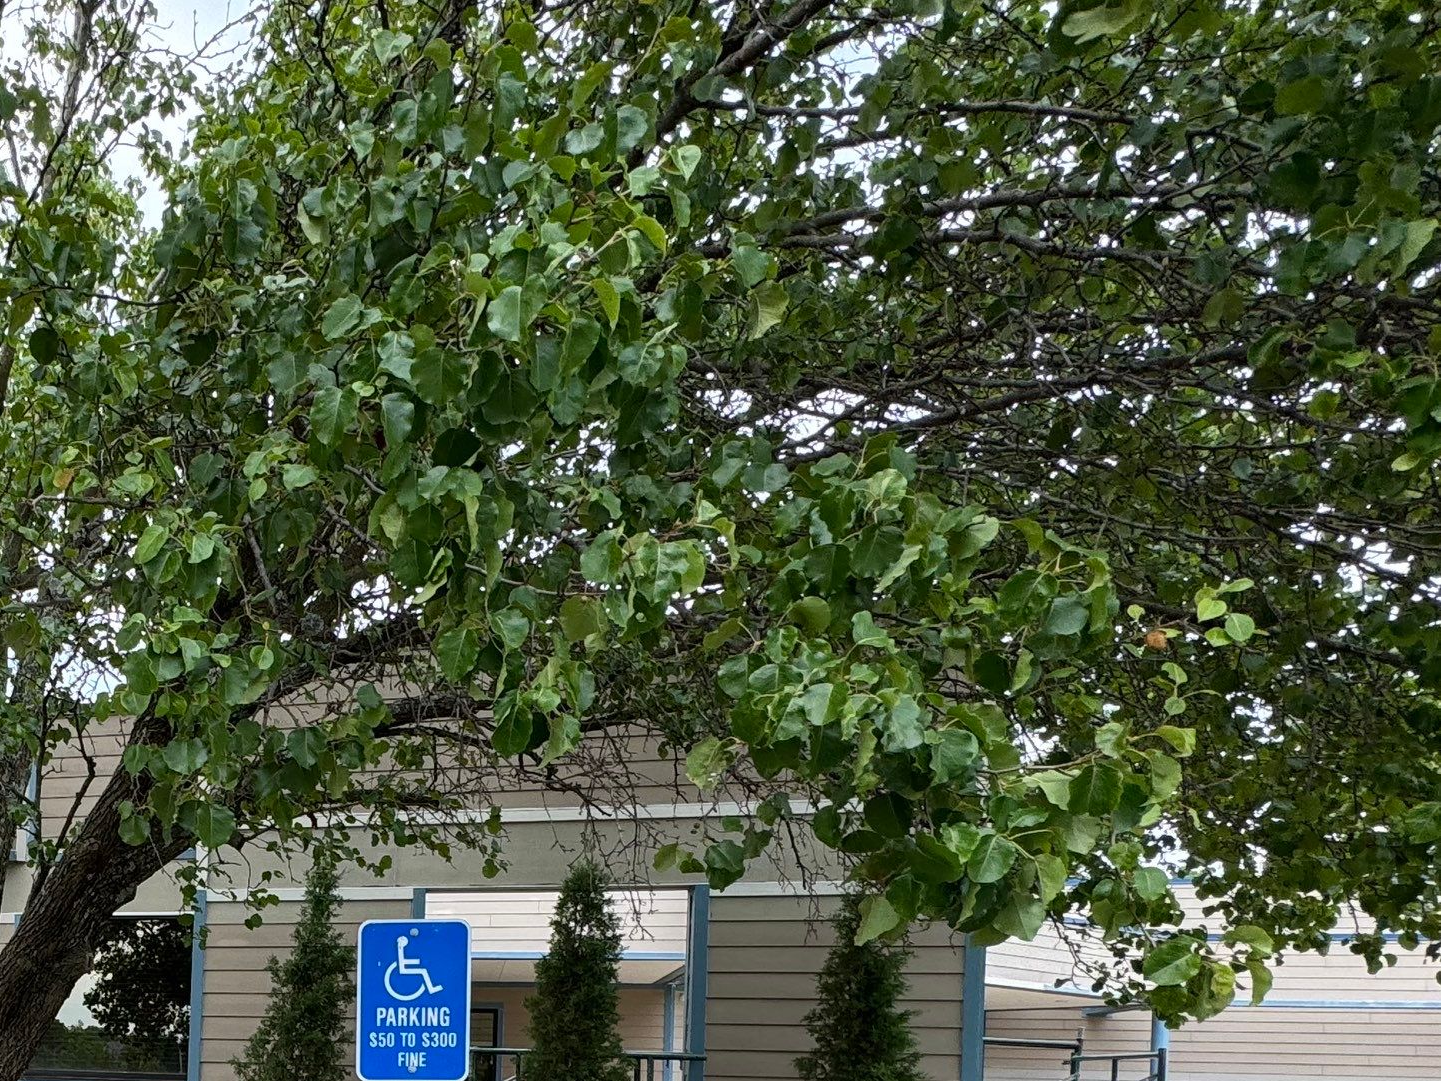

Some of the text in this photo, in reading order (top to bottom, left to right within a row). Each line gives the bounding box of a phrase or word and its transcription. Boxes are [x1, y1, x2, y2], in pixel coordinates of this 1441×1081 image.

[376, 1007, 450, 1027] PARKING
[369, 1031, 457, 1048] $50 TO $300
[397, 1052, 427, 1067] FINE
